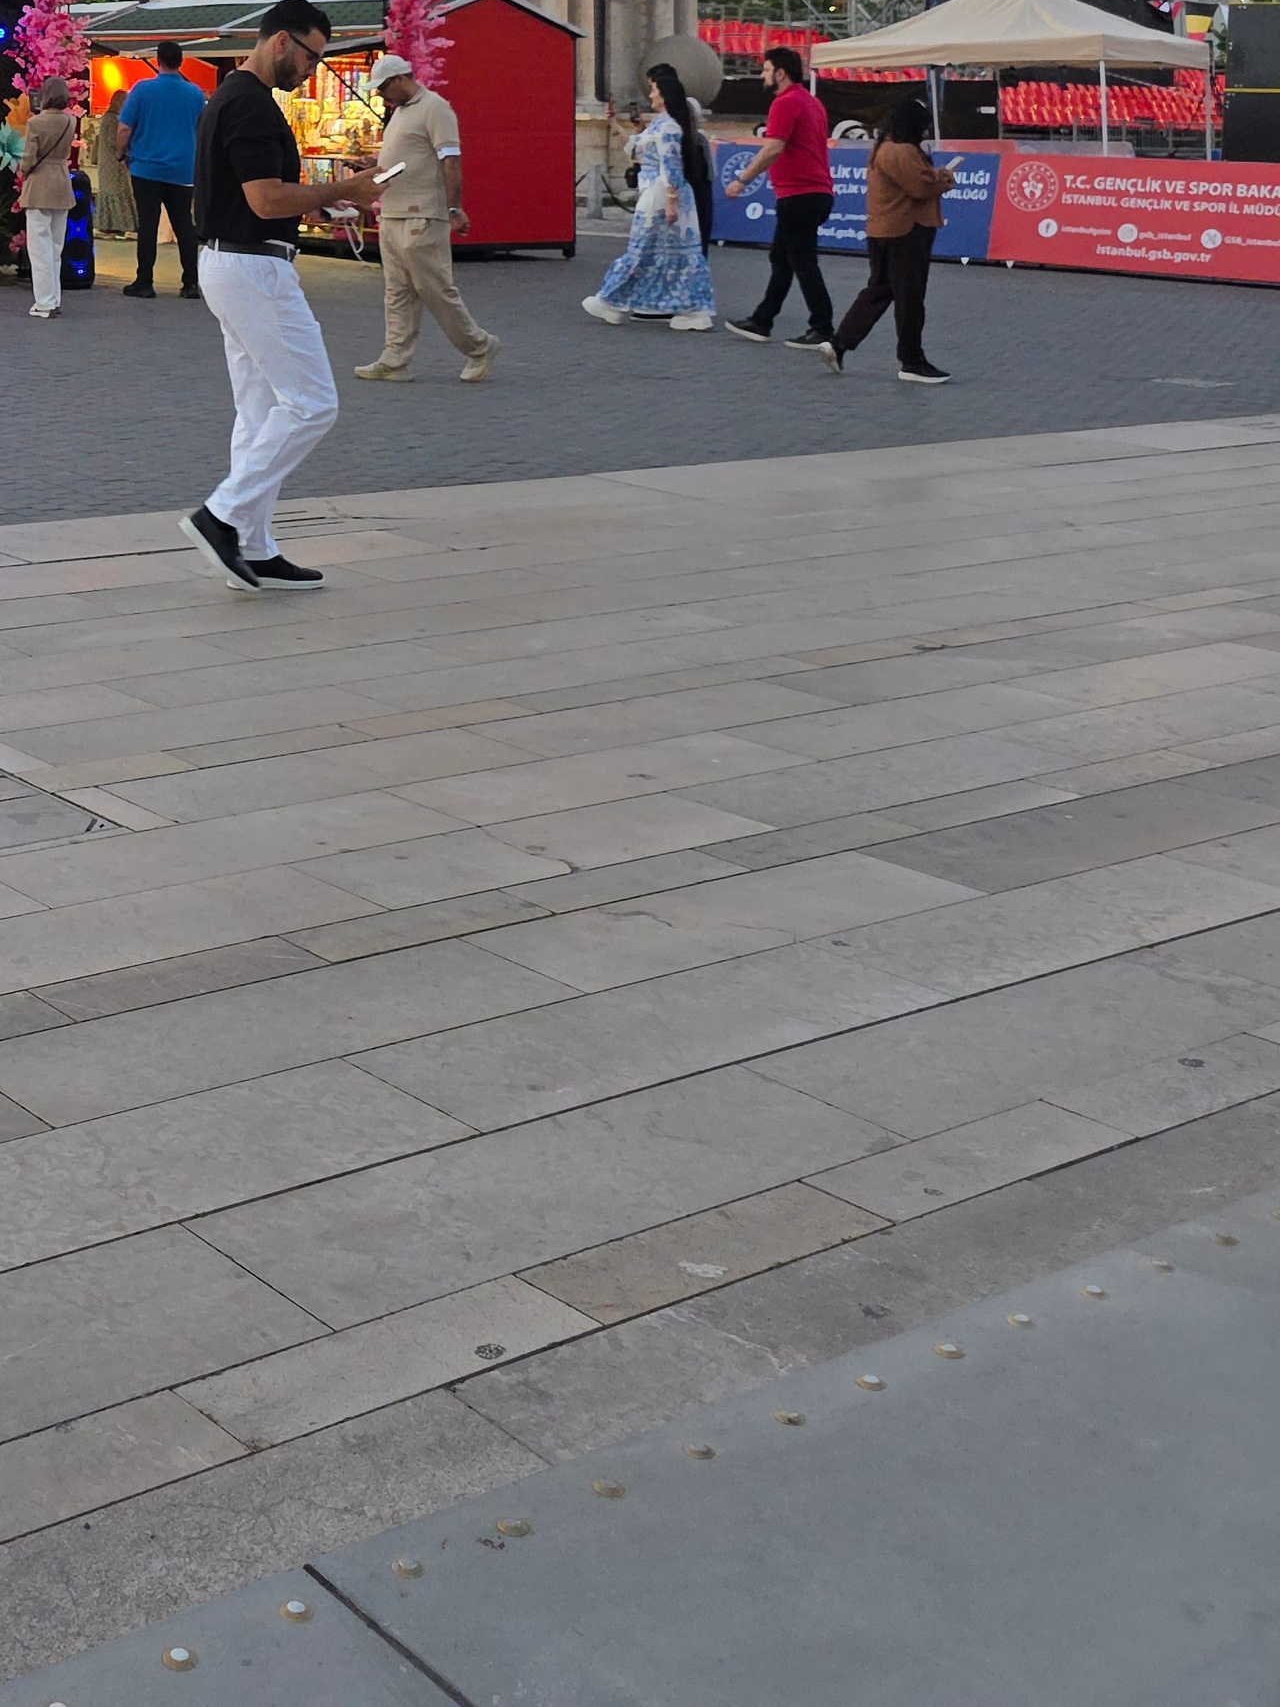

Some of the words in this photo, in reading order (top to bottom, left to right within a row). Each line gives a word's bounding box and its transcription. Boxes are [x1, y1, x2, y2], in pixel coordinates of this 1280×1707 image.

[1063, 174, 1091, 189] T.C.
[1093, 176, 1162, 195] GENÇLİK
[1164, 180, 1186, 194] VE
[1188, 181, 1233, 197] SPOR
[1061, 192, 1118, 207] İSTANBUL
[1120, 197, 1173, 211] GENÇLİK
[1174, 200, 1190, 211] VE
[1192, 201, 1226, 213] SPOR
